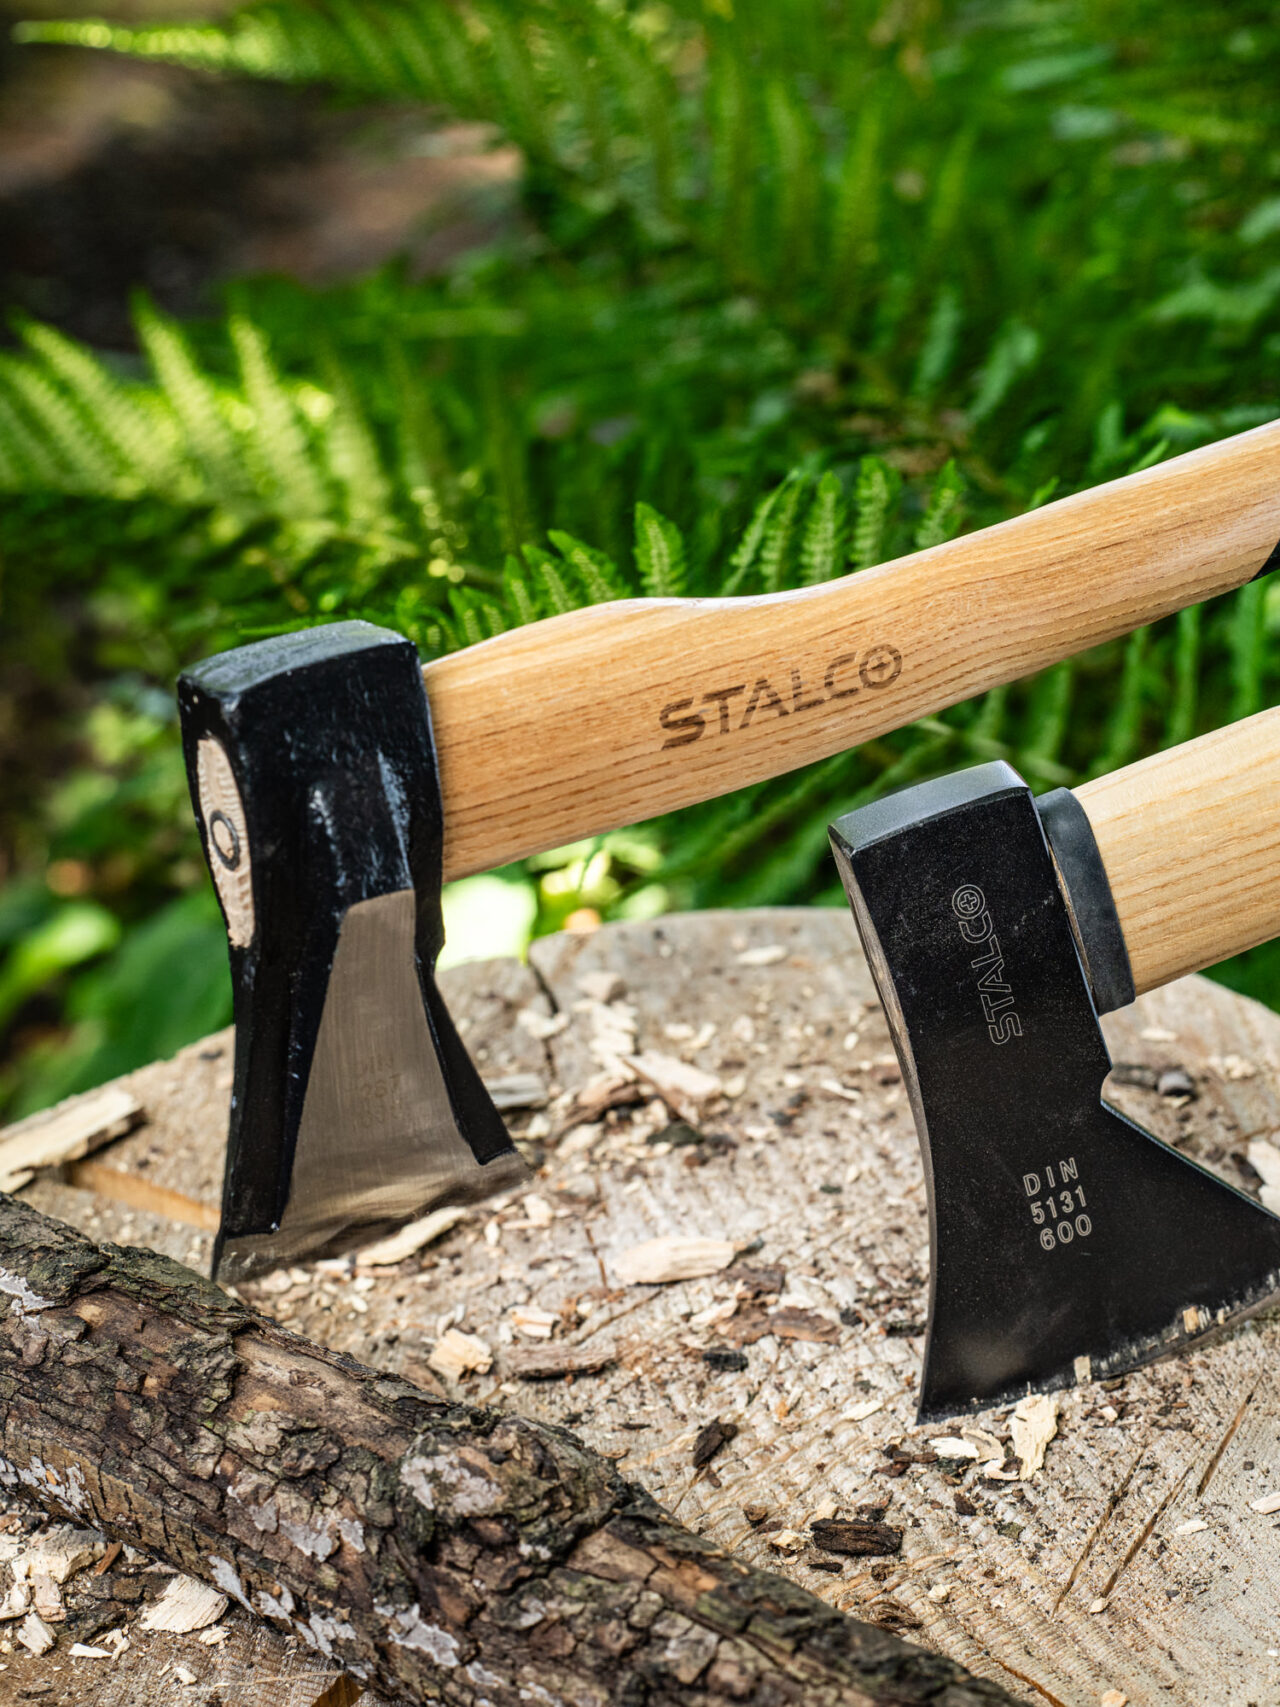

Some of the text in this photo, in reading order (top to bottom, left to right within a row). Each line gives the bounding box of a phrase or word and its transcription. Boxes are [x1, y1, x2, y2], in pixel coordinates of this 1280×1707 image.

[659, 643, 902, 750] STALCO
[952, 884, 1022, 1044] STALCO
[1023, 1157, 1078, 1196] DIN
[1030, 1185, 1087, 1224] 5131
[1040, 1214, 1092, 1250] 600
